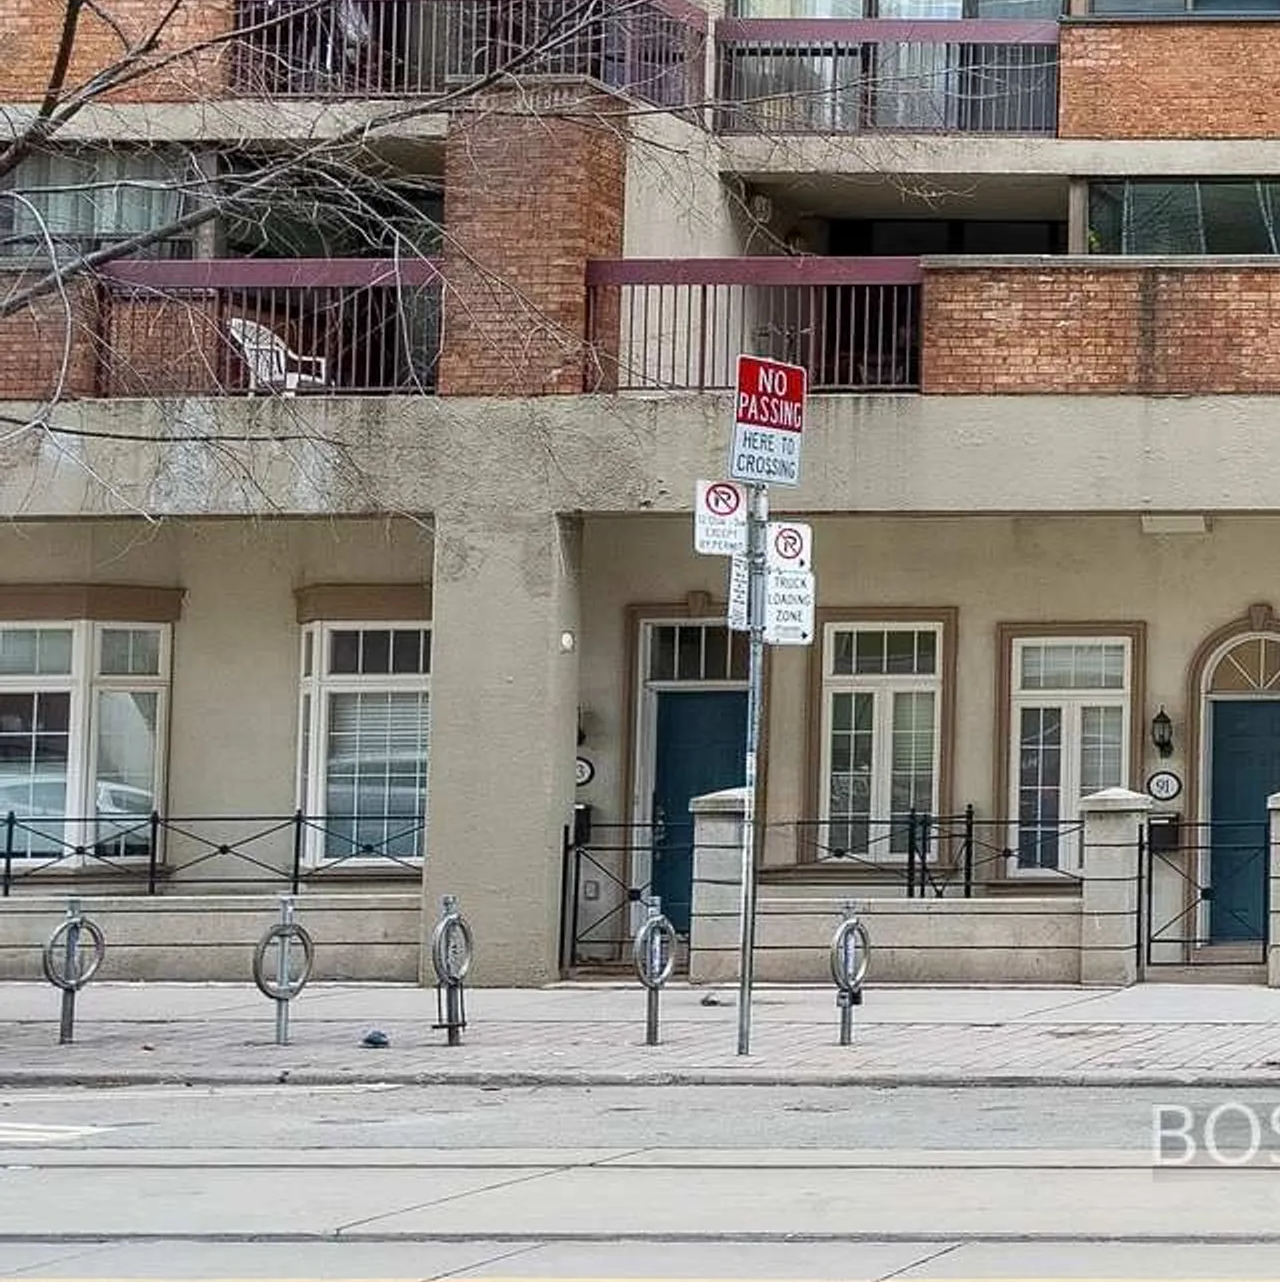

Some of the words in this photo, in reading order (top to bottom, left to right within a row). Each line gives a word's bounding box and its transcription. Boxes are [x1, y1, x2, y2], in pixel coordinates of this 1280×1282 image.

[758, 365, 788, 396] NO
[738, 392, 802, 429] PASSING
[742, 430, 775, 453] HERE
[781, 437, 796, 456] TO
[736, 453, 797, 479] CROSSING
[774, 576, 808, 589] TRUCK
[767, 592, 812, 607] LOADING
[775, 609, 804, 623] ZONE
[1155, 779, 1170, 794] 91
